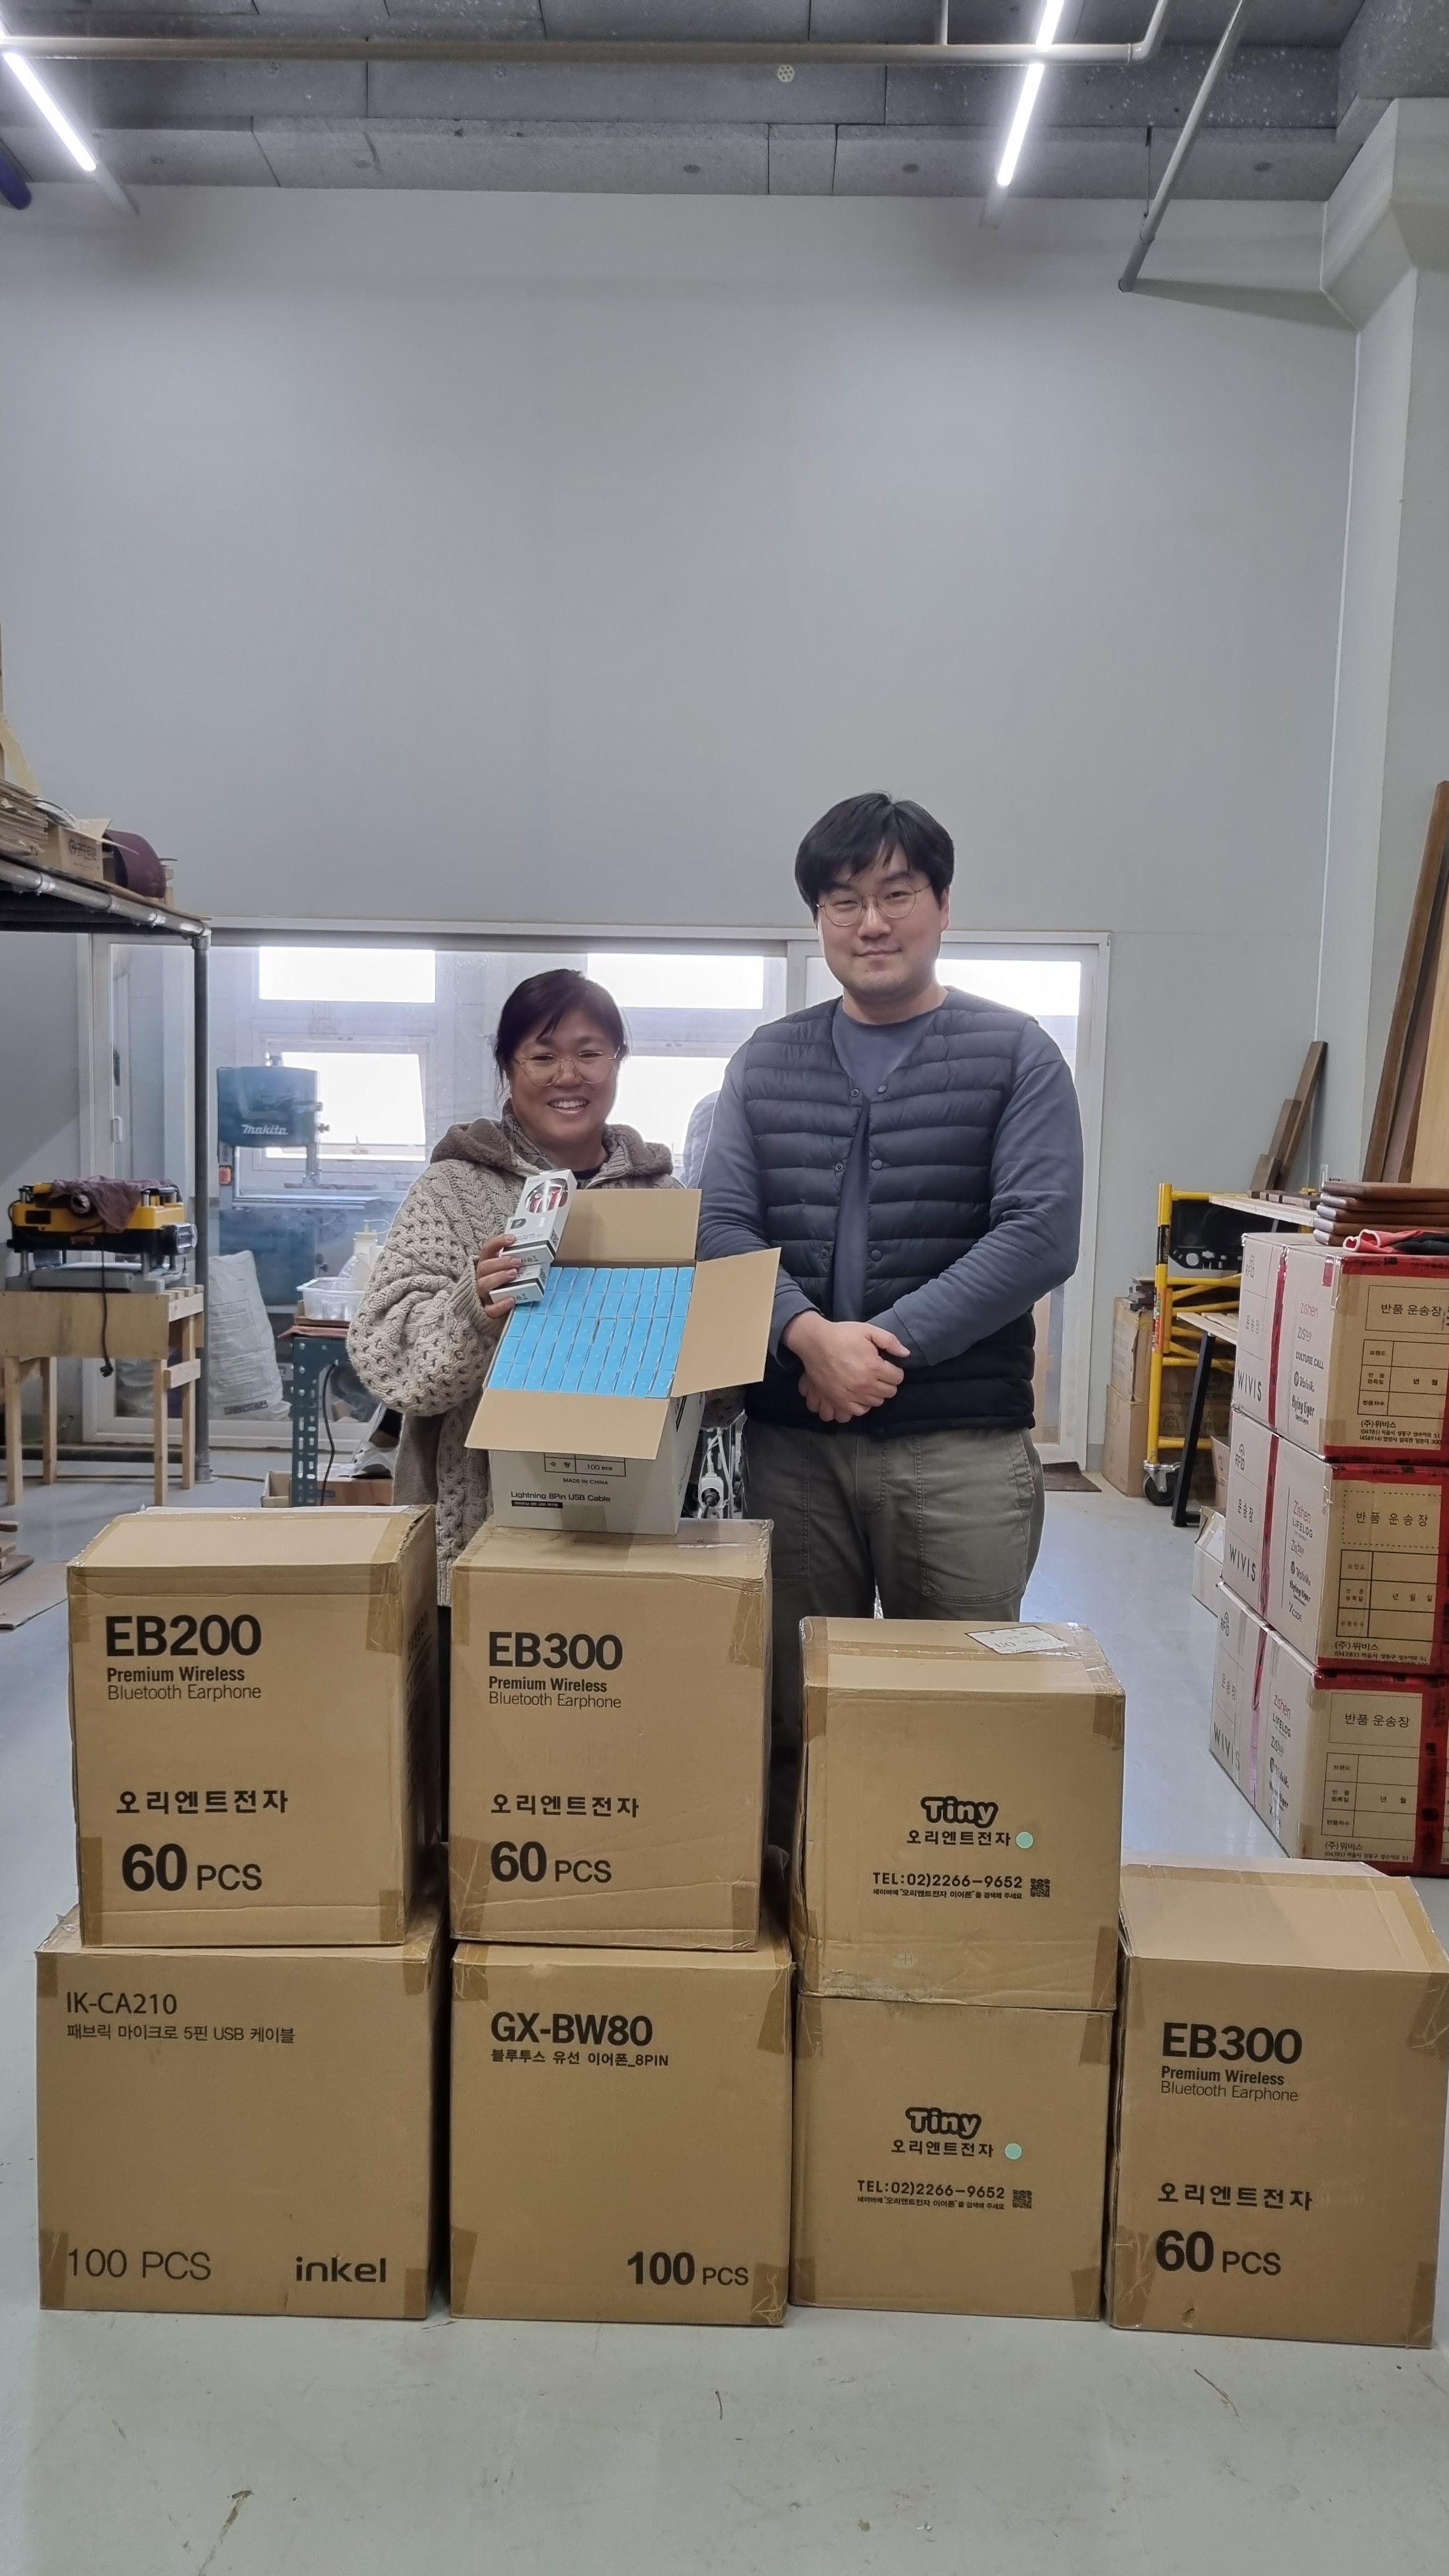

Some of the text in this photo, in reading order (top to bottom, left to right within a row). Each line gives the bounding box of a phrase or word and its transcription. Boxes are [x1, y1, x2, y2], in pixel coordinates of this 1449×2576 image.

[1381, 1304, 1403, 1315] 반품
[1407, 1305, 1443, 1317] 운송장
[1246, 1315, 1259, 1334] 운송장
[1296, 1351, 1324, 1369] CULTURE CALL
[1238, 1370, 1262, 1402] WIVIS
[1235, 1453, 1245, 1470] RFID
[1292, 1519, 1313, 1538] LIFELOG
[1230, 1544, 1256, 1582] WIVIS
[106, 1614, 261, 1657] EB200
[489, 1631, 622, 1671] EB300
[107, 1666, 245, 1682] Premium Wireless
[489, 1676, 607, 1692] Premium Wireless
[108, 1684, 261, 1701] Bluetooth Earphone
[489, 1692, 621, 1709] Bluetooth Earphone
[1346, 1713, 1409, 1728] 반품 운송장
[1214, 1722, 1239, 1771] WIVIS
[116, 1790, 288, 1814] 오리엔트전자
[491, 1793, 639, 1818] 오리엔트전자
[921, 1796, 999, 1828] Tiny
[907, 1830, 1011, 1846] 오리엔트전자
[122, 1843, 262, 1892] 60 PCS
[491, 1840, 611, 1883] 60 PCS
[873, 1873, 1022, 1888] TEL:02)2266-9652
[66, 1992, 177, 2014] IK-CA210
[66, 2024, 295, 2043] 패브릭 마이크로 5핀 USB 케이블
[491, 2011, 652, 2046] GX-BW80
[1162, 2021, 1302, 2064] EB300
[491, 2049, 669, 2067] 블루투스 유선 이어폰_8PIN
[1162, 2066, 1284, 2085] Premium Wireless
[1161, 2081, 1298, 2101] Bluetooth Earphone
[905, 2107, 981, 2140] Tiny
[891, 2139, 993, 2158] 오리엔트전자
[857, 2180, 1005, 2199] TEL:02)2266-9652
[1158, 2182, 1312, 2211] 오리엔트전자
[1156, 2230, 1281, 2275] 60 PCS
[68, 2249, 211, 2281] 100 PCS
[296, 2256, 387, 2283] inkel
[627, 2251, 749, 2285] 100 PCS
